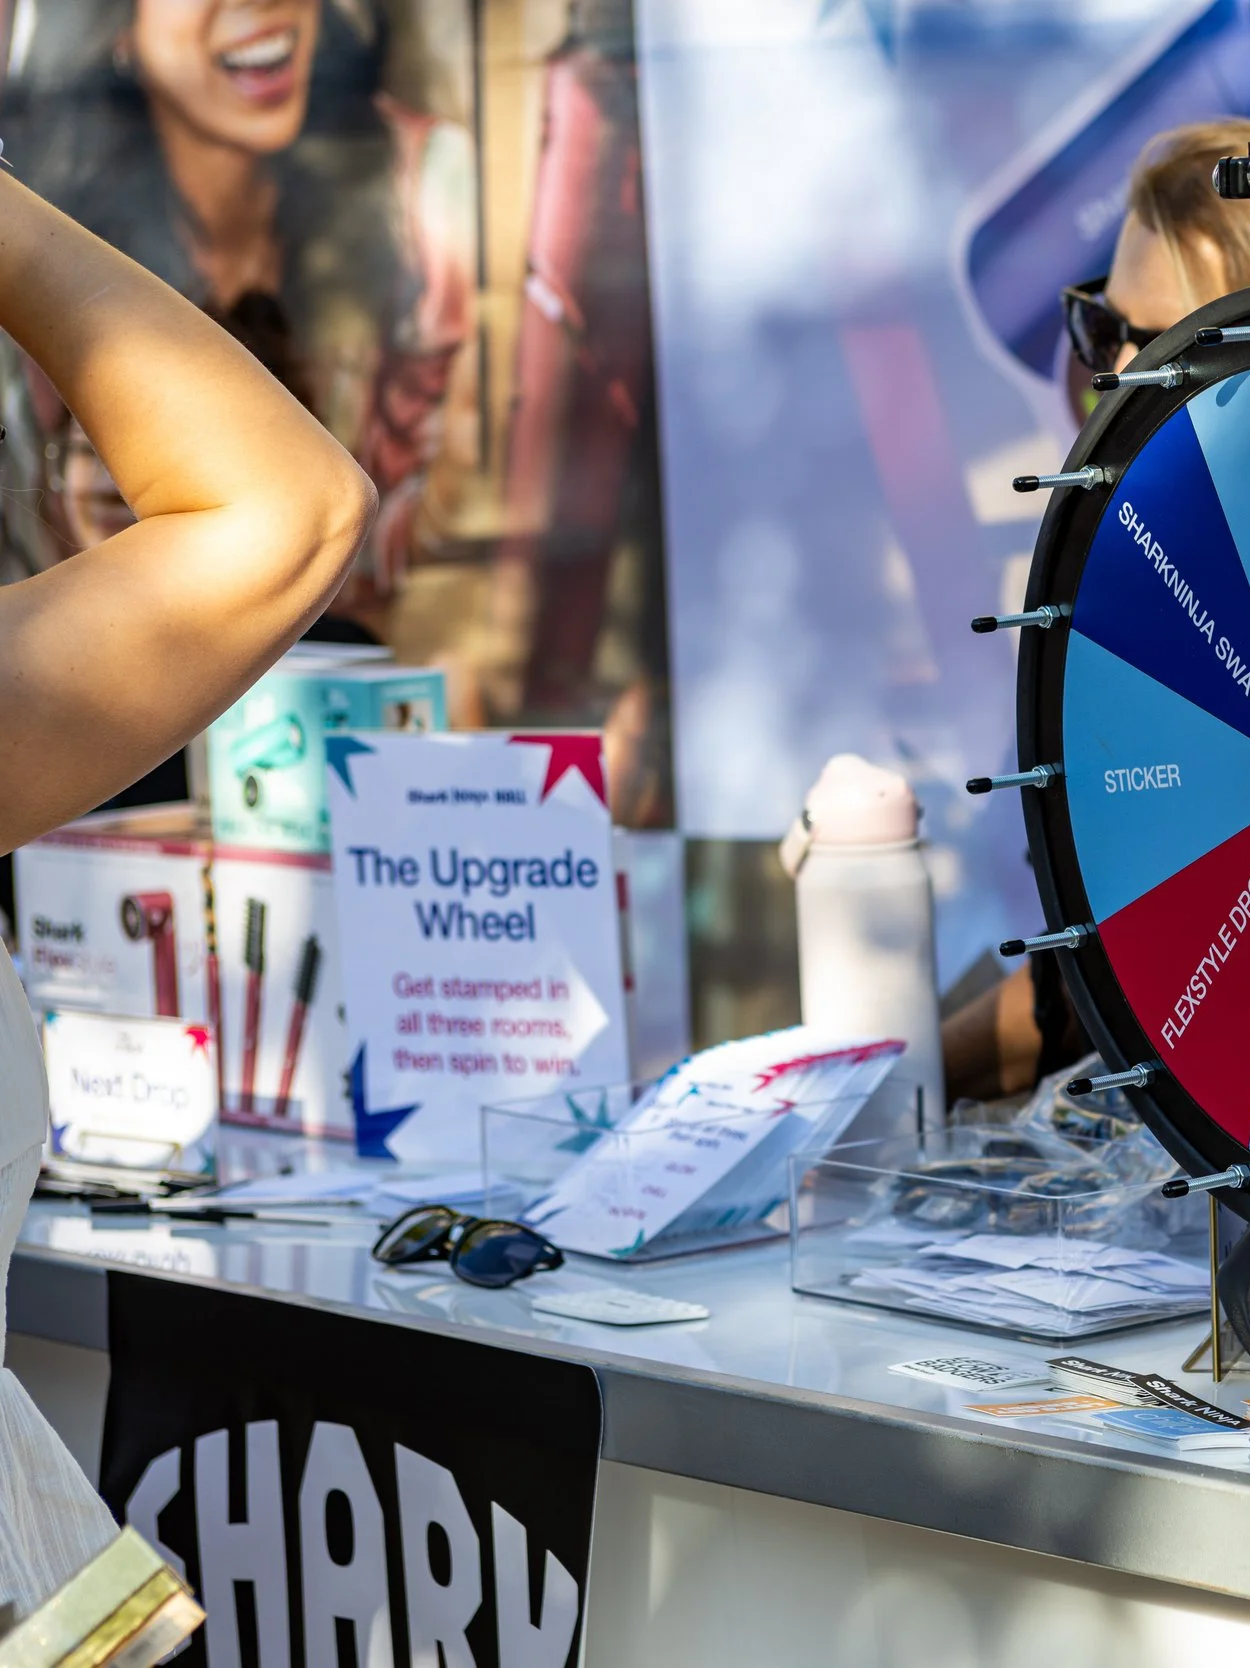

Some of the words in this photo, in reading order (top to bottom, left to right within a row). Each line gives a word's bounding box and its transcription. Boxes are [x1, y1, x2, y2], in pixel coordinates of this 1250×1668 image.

[1118, 501, 1215, 645] SHARKNINJA
[1104, 764, 1182, 793] STICKER
[348, 846, 420, 887] The
[430, 846, 599, 898] Upgrade
[415, 900, 537, 941] Wheel
[393, 971, 435, 1000] Get
[440, 977, 542, 1003] stamped
[549, 976, 569, 1000] in
[1160, 923, 1239, 1050] FLEXSTYLE
[396, 1010, 421, 1035] all
[426, 1012, 485, 1037] three
[393, 1048, 443, 1073] then
[450, 1050, 498, 1076] spin
[503, 1052, 528, 1075] to
[914, 1360, 1006, 1385] BADGERS
[1146, 1380, 1198, 1408] Shark
